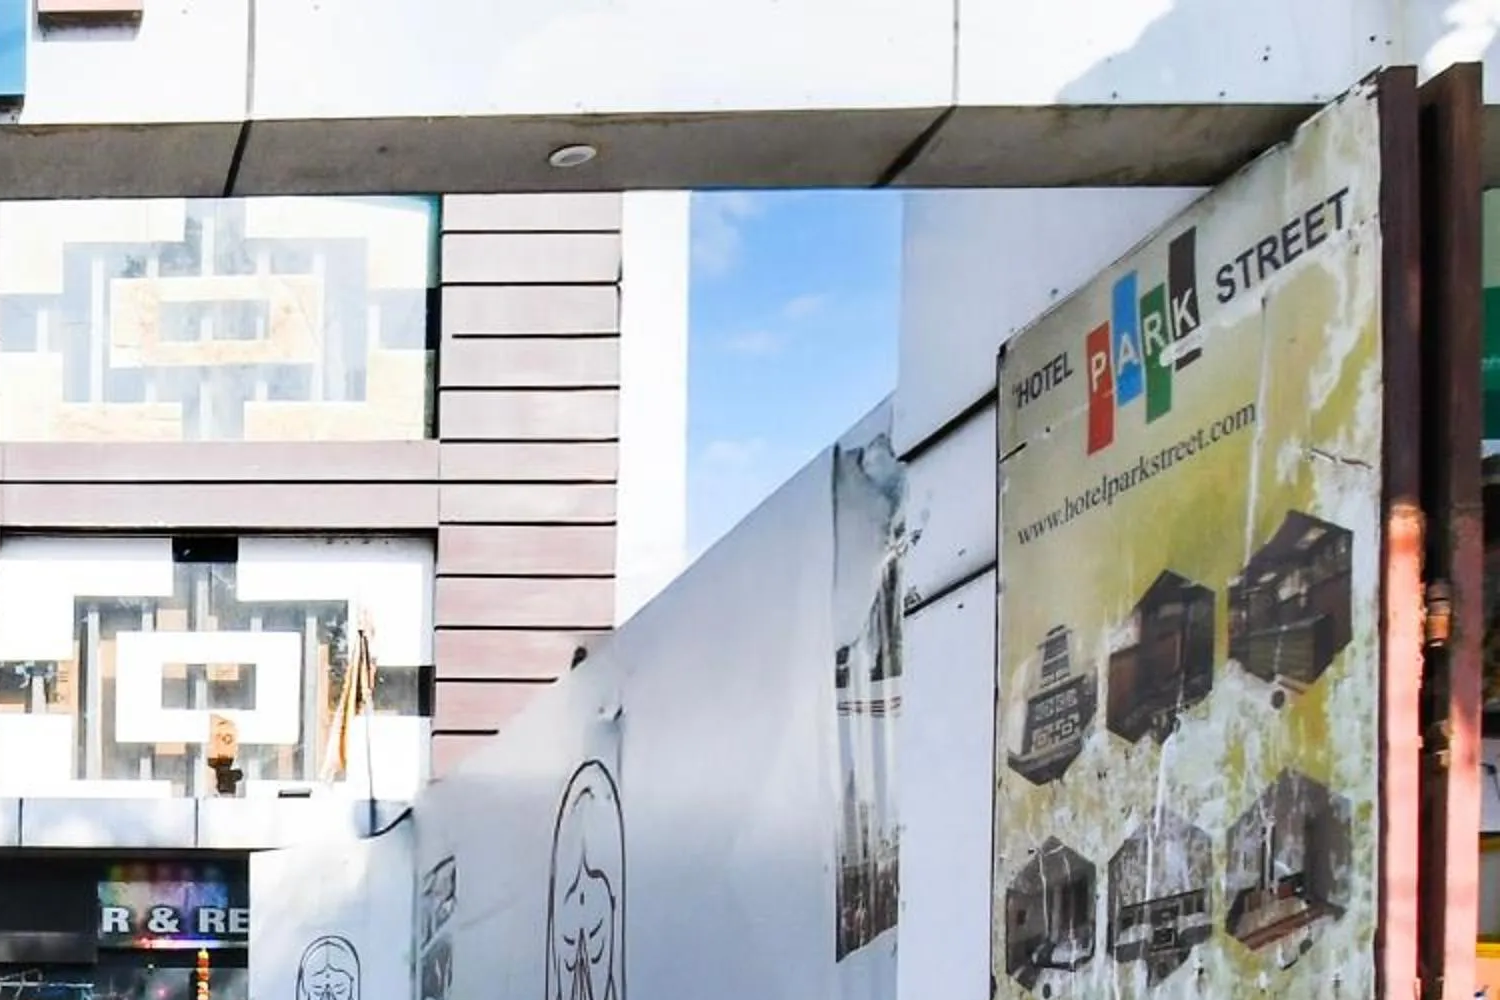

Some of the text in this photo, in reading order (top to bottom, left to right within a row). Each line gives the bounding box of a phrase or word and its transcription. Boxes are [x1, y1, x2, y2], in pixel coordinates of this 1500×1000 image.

[1016, 187, 1350, 409] HOTEL PARK STREET
[1017, 402, 1257, 545] www.hotelparkstreet.com
[101, 907, 131, 933] R
[147, 907, 181, 933] &
